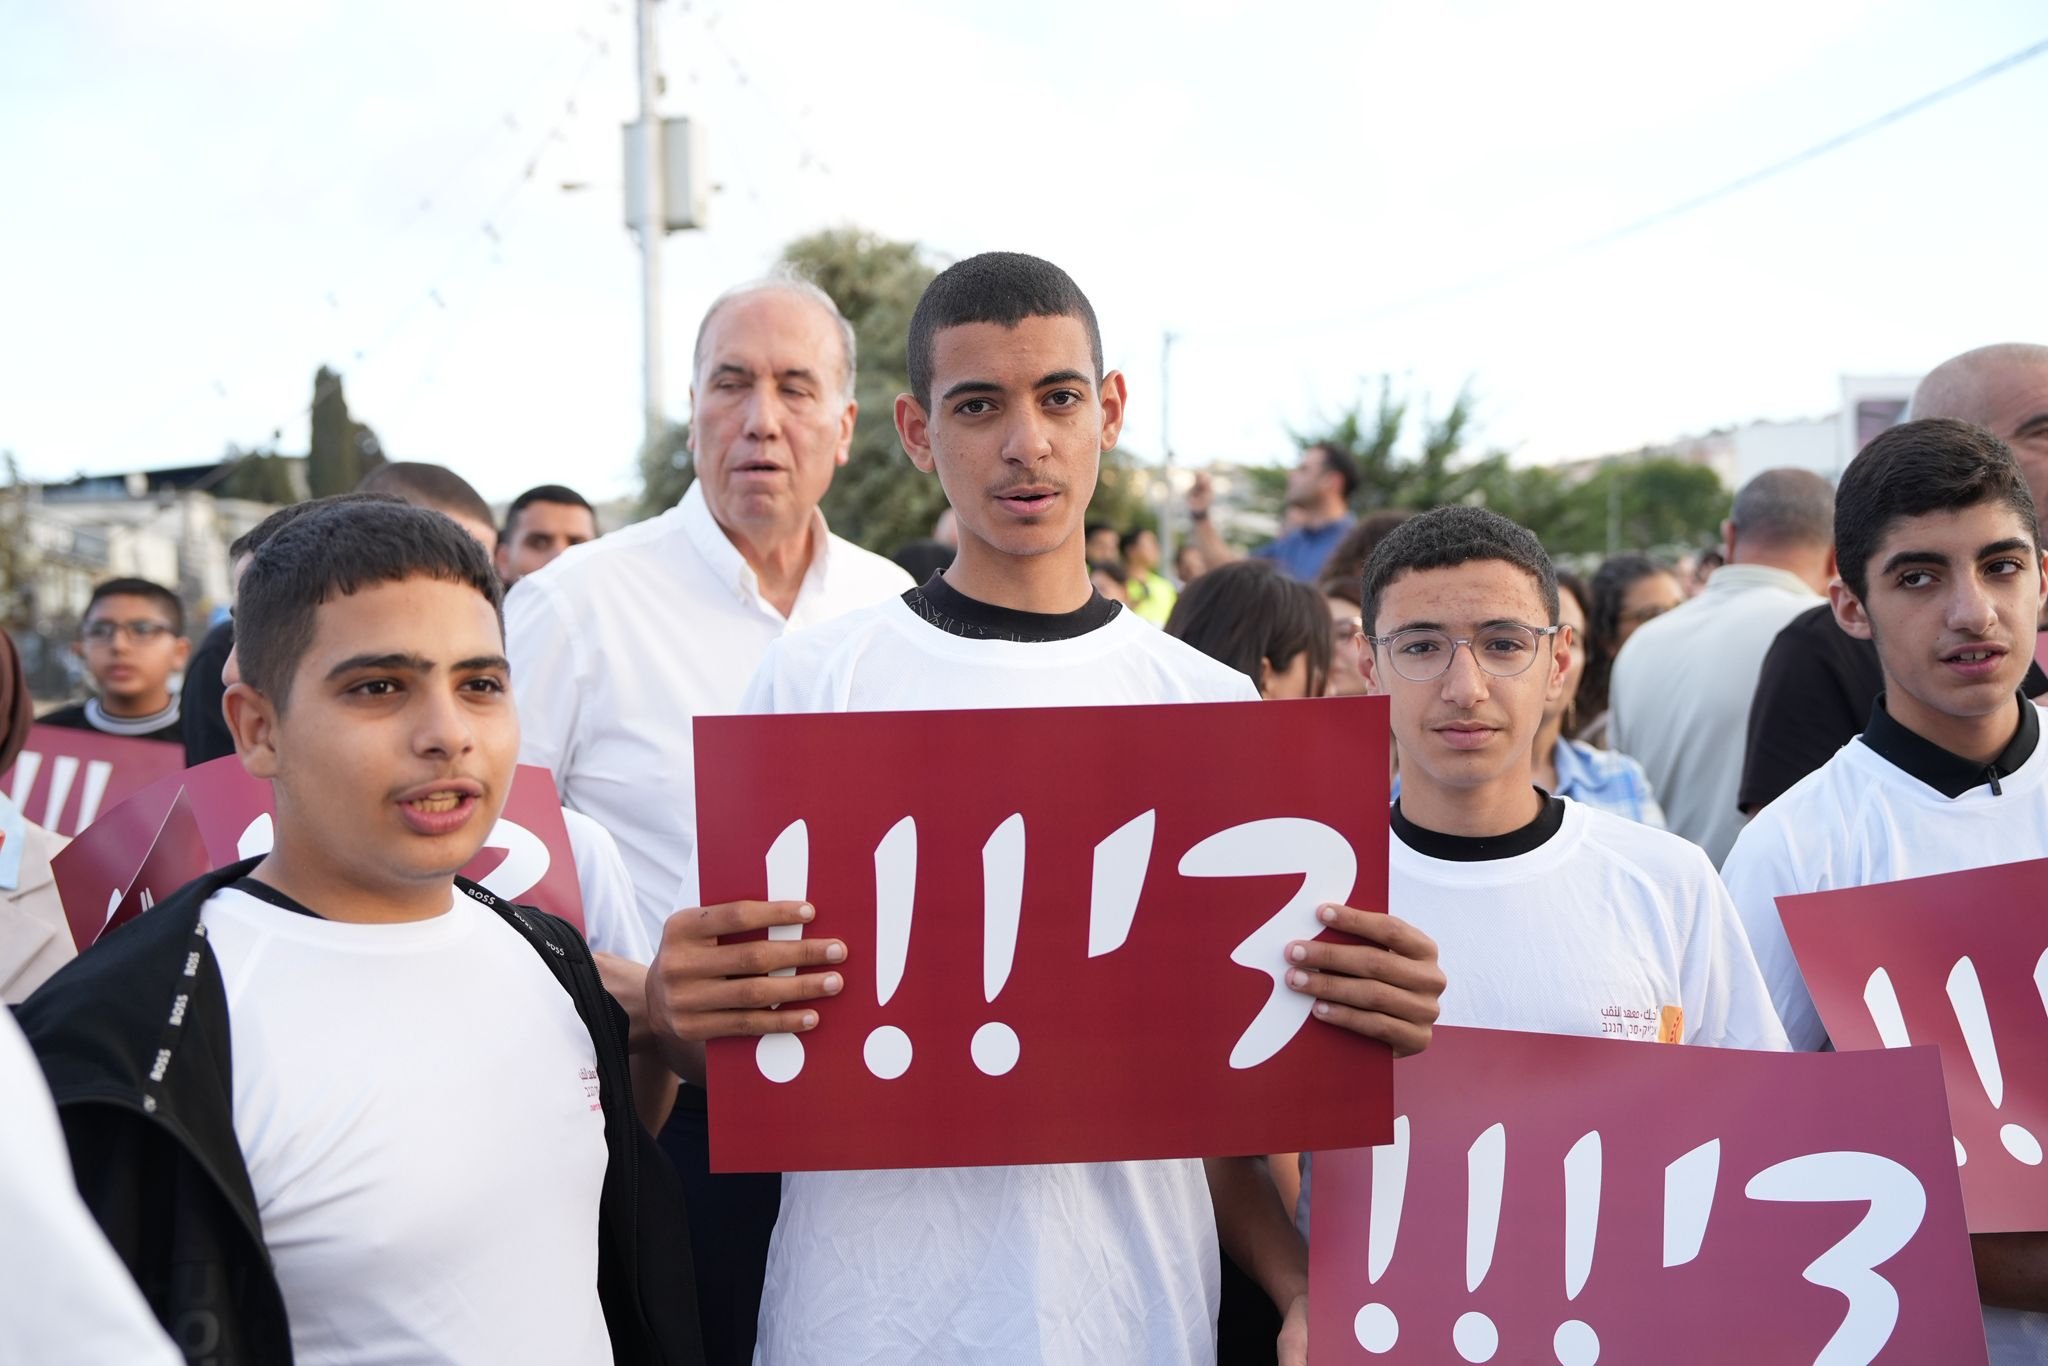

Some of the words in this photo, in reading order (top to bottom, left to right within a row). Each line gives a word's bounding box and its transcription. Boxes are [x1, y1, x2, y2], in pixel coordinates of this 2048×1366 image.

[467, 888, 496, 905] BOSS
[183, 951, 200, 977] BOSS
[168, 994, 188, 1026] BOSS
[149, 1049, 172, 1082] BOSS
